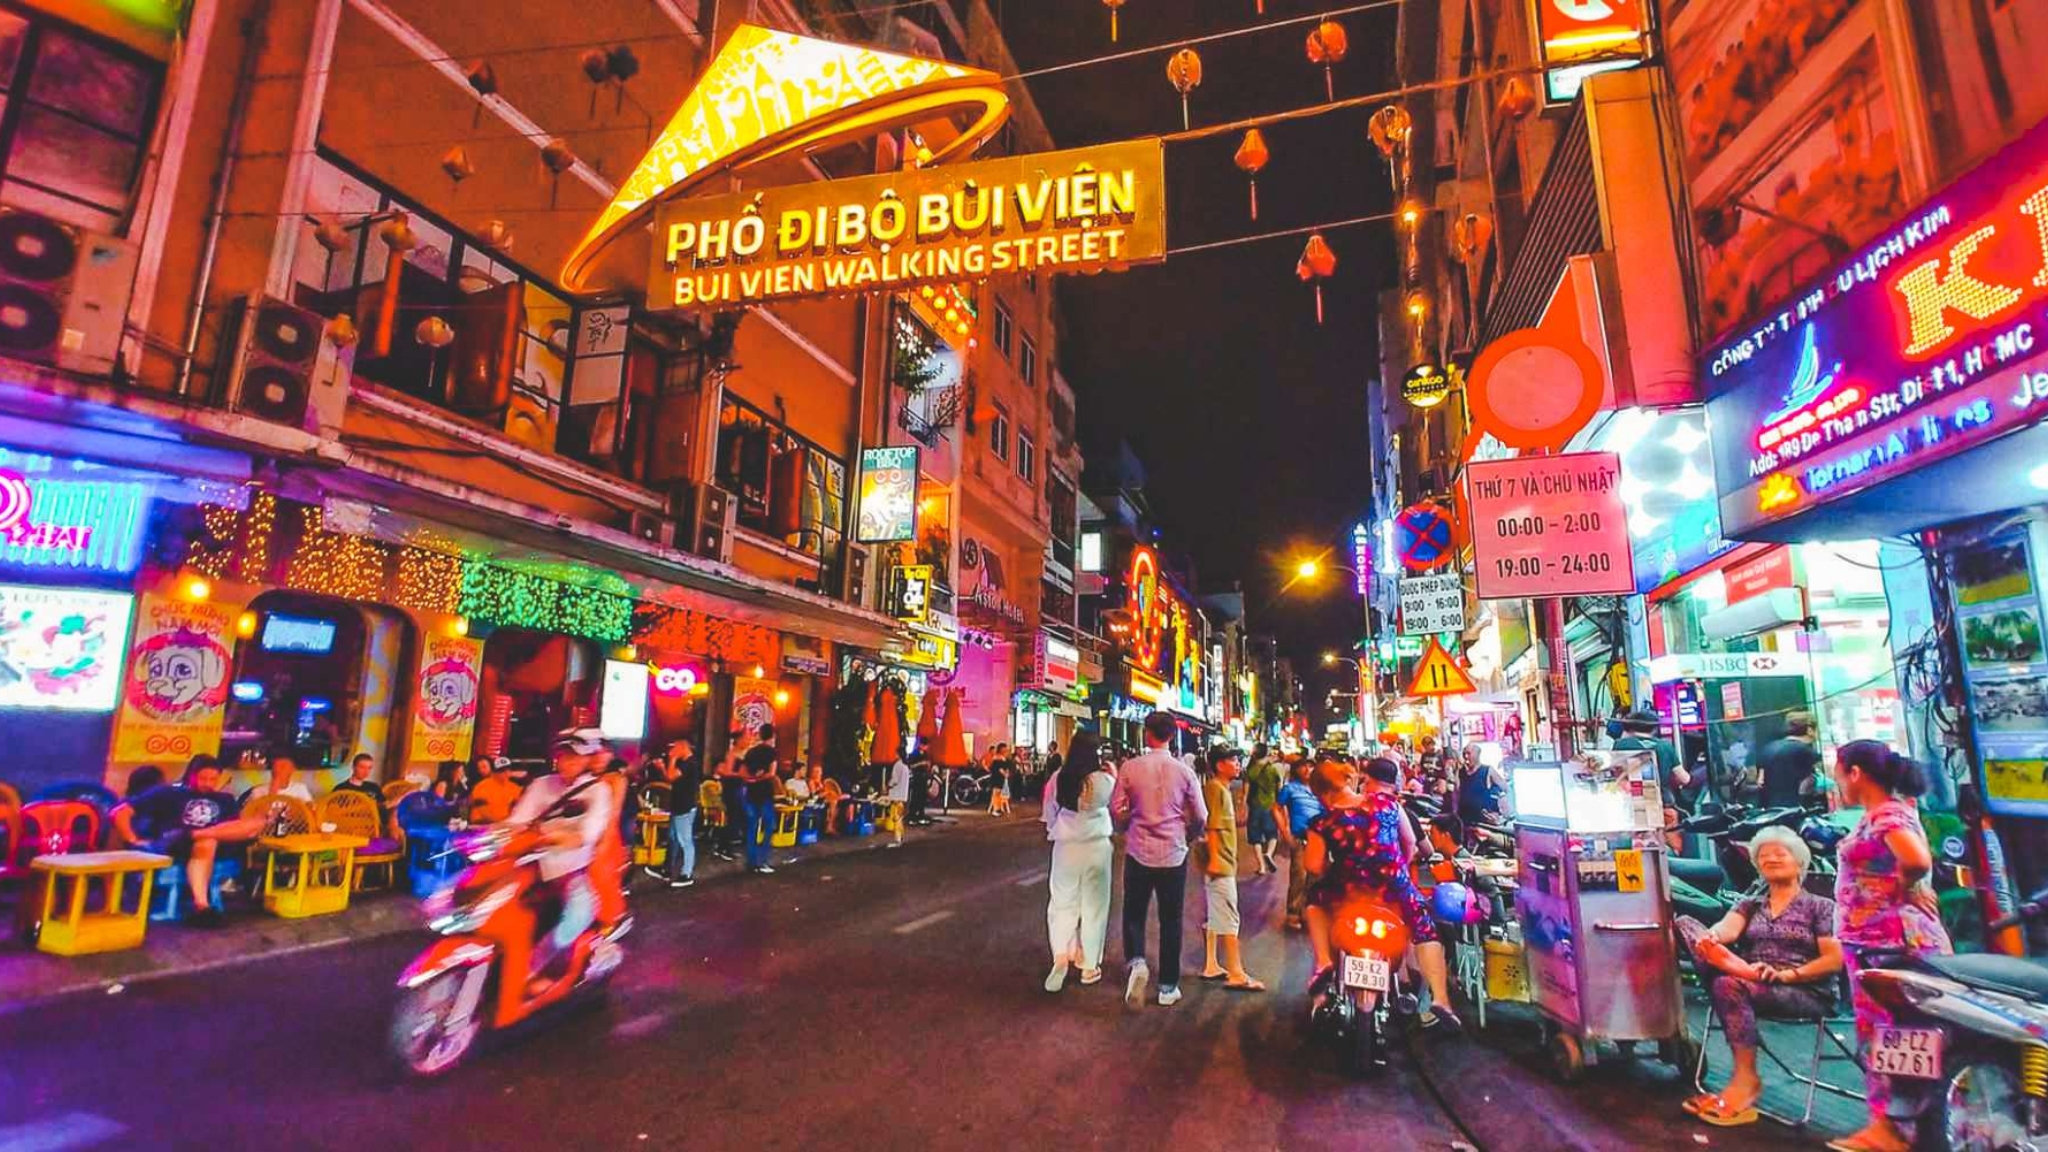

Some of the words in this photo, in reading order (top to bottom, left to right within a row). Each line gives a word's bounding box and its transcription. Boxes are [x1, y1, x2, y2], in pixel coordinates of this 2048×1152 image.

[666, 191, 765, 262] PHỐ
[777, 206, 829, 251] ĐI
[836, 188, 906, 253] BỘ
[918, 178, 1005, 236] BÙI
[1905, 206, 1950, 248] KIM
[675, 273, 730, 305] BUI
[740, 262, 814, 297] VIEN
[823, 243, 985, 288] WALKING
[992, 229, 1125, 269] STREET
[864, 446, 916, 460] ROOFTOP
[876, 458, 902, 469] BBQ
[1749, 457, 1778, 477] Add:
[1475, 474, 1502, 499] THỨ
[1507, 479, 1516, 497] 7
[1520, 471, 1540, 496] VÀ
[1544, 469, 1572, 494] CHỦ
[1577, 466, 1616, 494] NHẬT
[1497, 516, 1544, 537] 00:00
[1563, 512, 1601, 533] 2:00
[1495, 557, 1541, 578] 19:00
[1561, 553, 1610, 574] 24:00
[1405, 599, 1425, 613] 9:00
[1441, 613, 1461, 627] 6:00
[1702, 657, 1748, 671] HSBC
